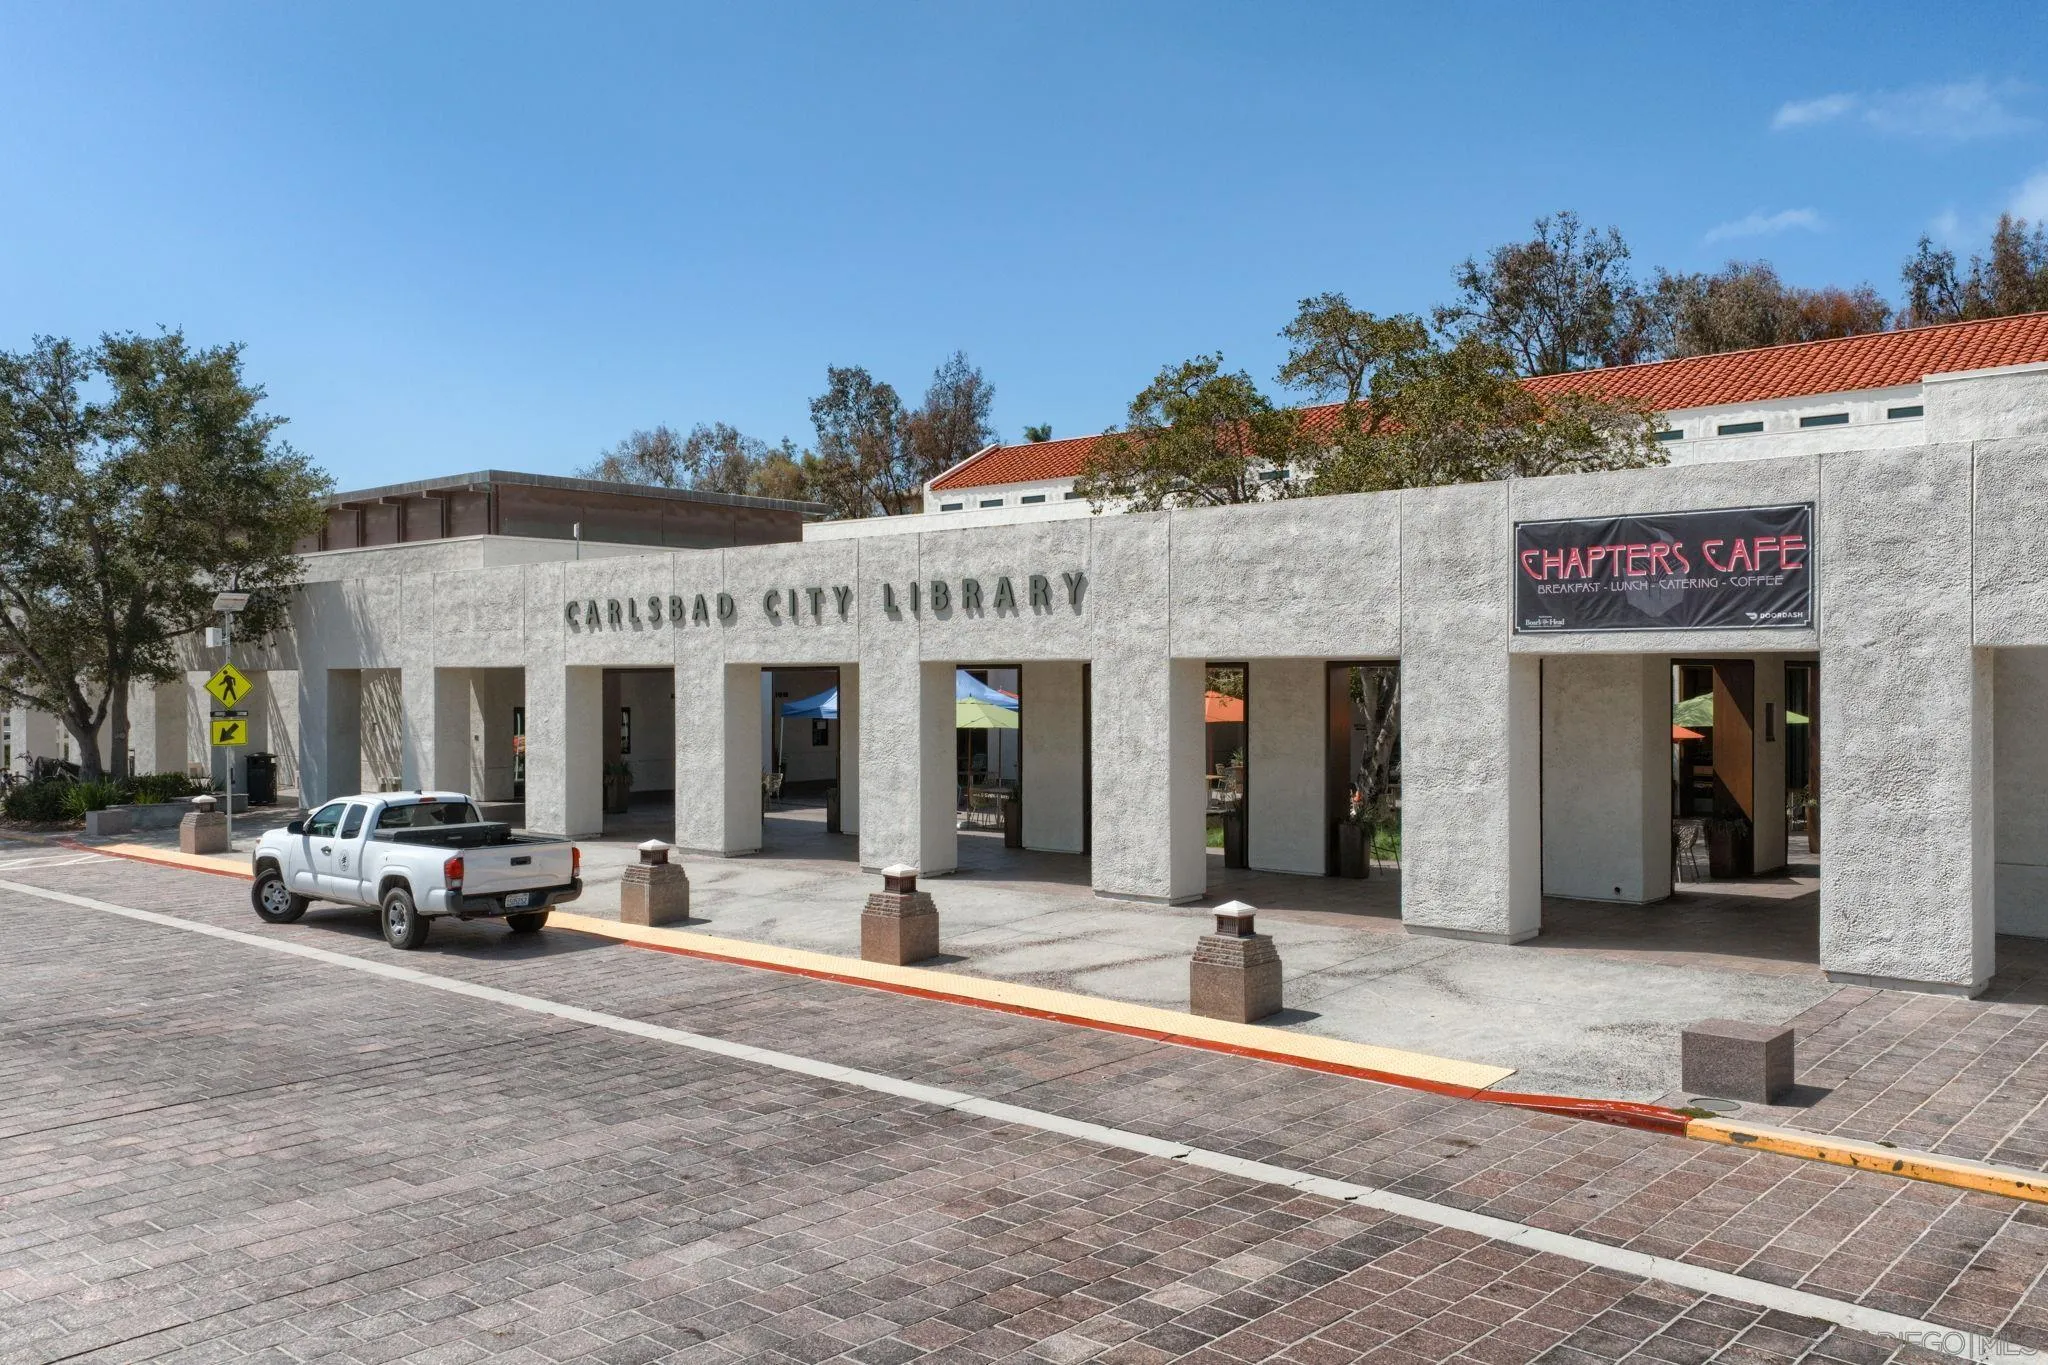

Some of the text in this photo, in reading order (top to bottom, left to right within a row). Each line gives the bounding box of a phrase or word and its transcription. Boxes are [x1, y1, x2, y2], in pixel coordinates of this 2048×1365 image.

[1520, 535, 1807, 580] CHAPTERS CAFE
[565, 571, 1084, 626] CARLSBAD CITY LIBRARY
[1537, 582, 1601, 594] BREAKFAST
[1610, 581, 1649, 592] LUNCH
[1659, 578, 1718, 590] CATERING
[1729, 575, 1784, 587] COFFEE
[1760, 611, 1803, 619] DOORDASH
